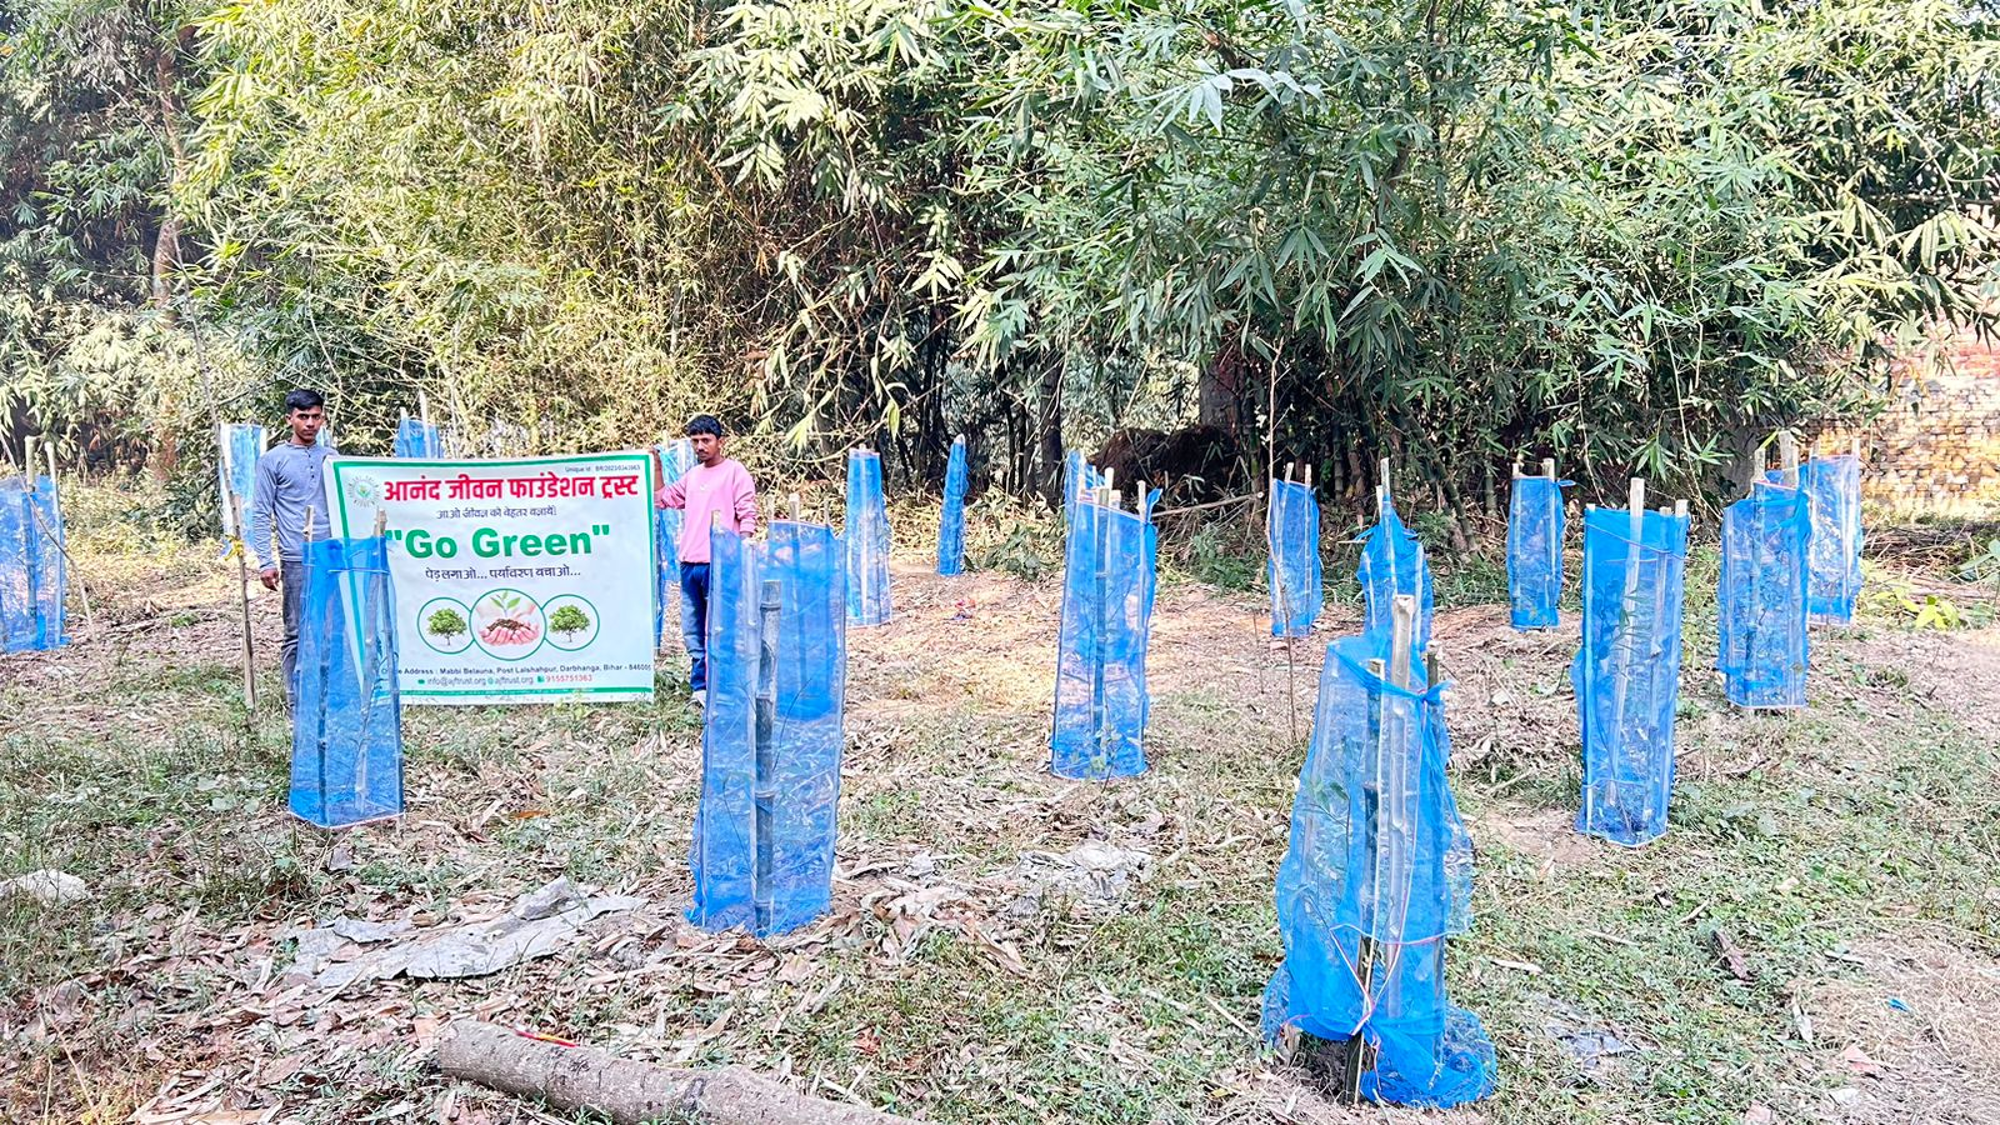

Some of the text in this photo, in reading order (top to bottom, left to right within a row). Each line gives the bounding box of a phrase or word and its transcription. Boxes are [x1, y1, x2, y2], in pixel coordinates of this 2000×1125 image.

[384, 475, 441, 501] आनंद
[445, 473, 504, 500] जीवन
[507, 472, 596, 498] फाउंडेशन
[600, 475, 639, 498] ट्रस्ट
[490, 506, 501, 517] को
[471, 524, 610, 558] Green"
[404, 667, 434, 675] Address
[496, 666, 513, 674] Post
